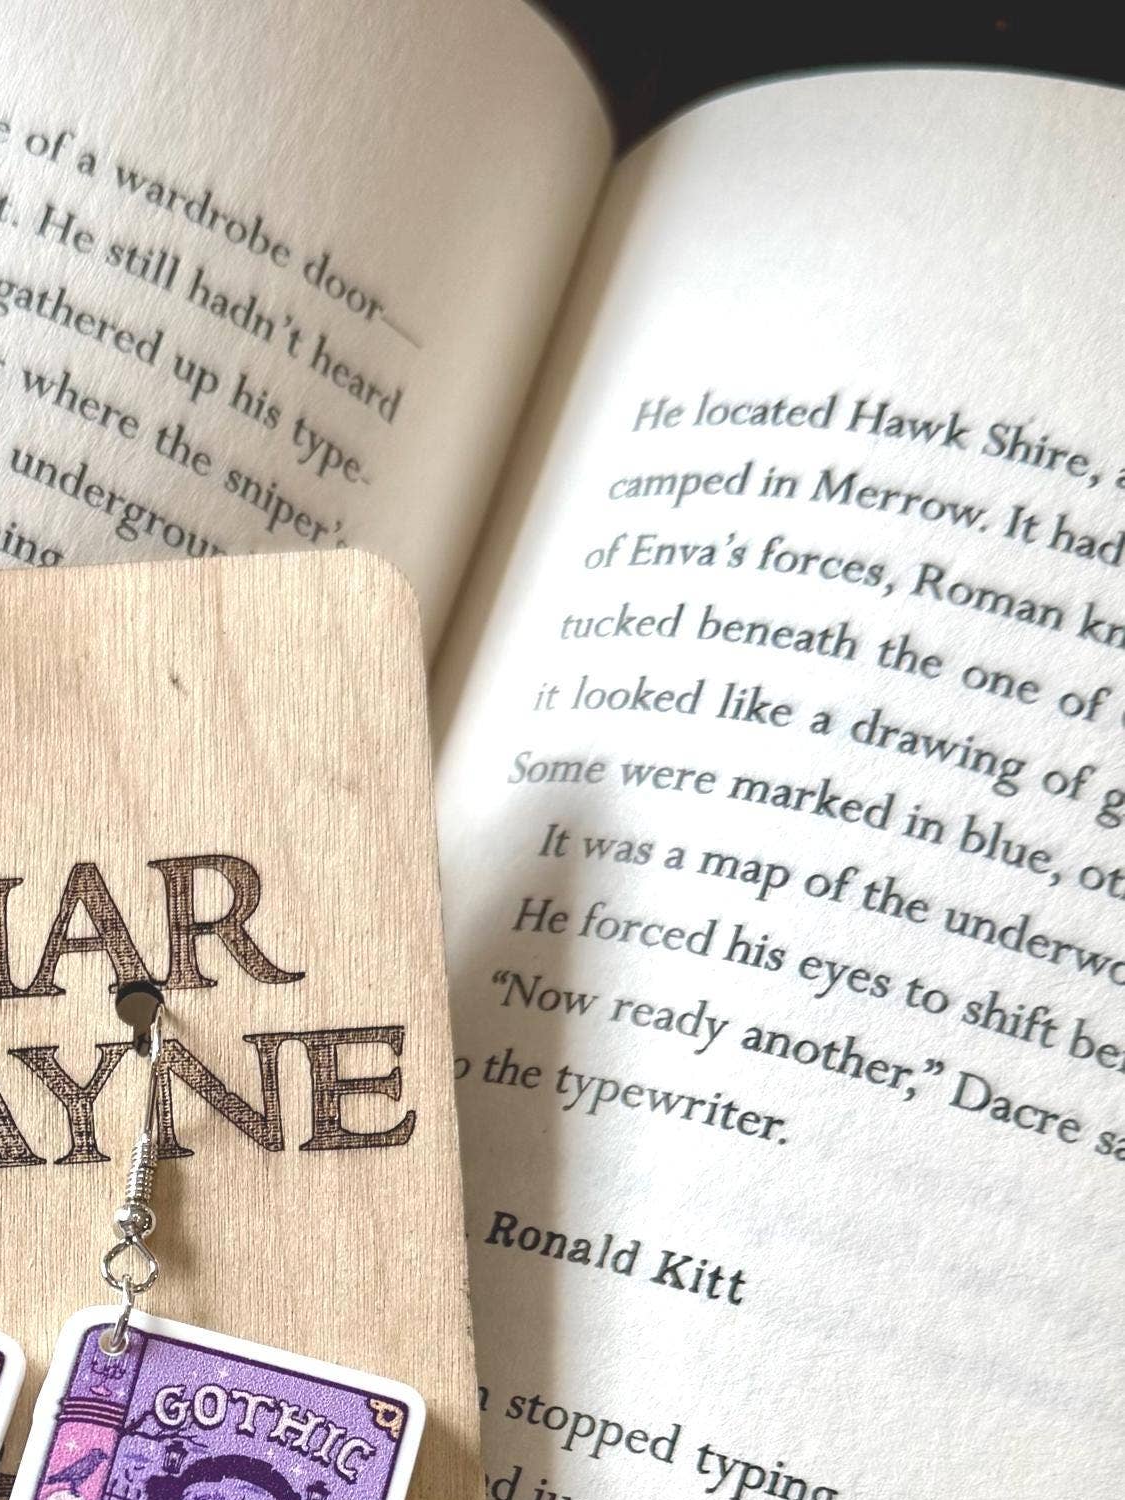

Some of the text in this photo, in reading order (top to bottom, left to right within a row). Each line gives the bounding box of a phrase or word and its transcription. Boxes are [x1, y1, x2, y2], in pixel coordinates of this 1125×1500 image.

[38, 203, 94, 252] He
[110, 244, 180, 290] still
[310, 333, 402, 422] heard
[174, 354, 219, 402] up
[231, 373, 281, 429] his
[635, 392, 1101, 488] He located Hawk Shire,
[586, 534, 622, 570] of
[758, 535, 895, 597] forces,
[911, 562, 1065, 630] Roman
[534, 676, 1097, 800] it looked like a drawing of
[538, 823, 930, 923] It was a map of the
[557, 1069, 788, 1145] typewriter.
[485, 1211, 746, 1306] Ronald Kitt
[153, 1384, 377, 1483] GOTHIC
[506, 1389, 683, 1464] stopped
